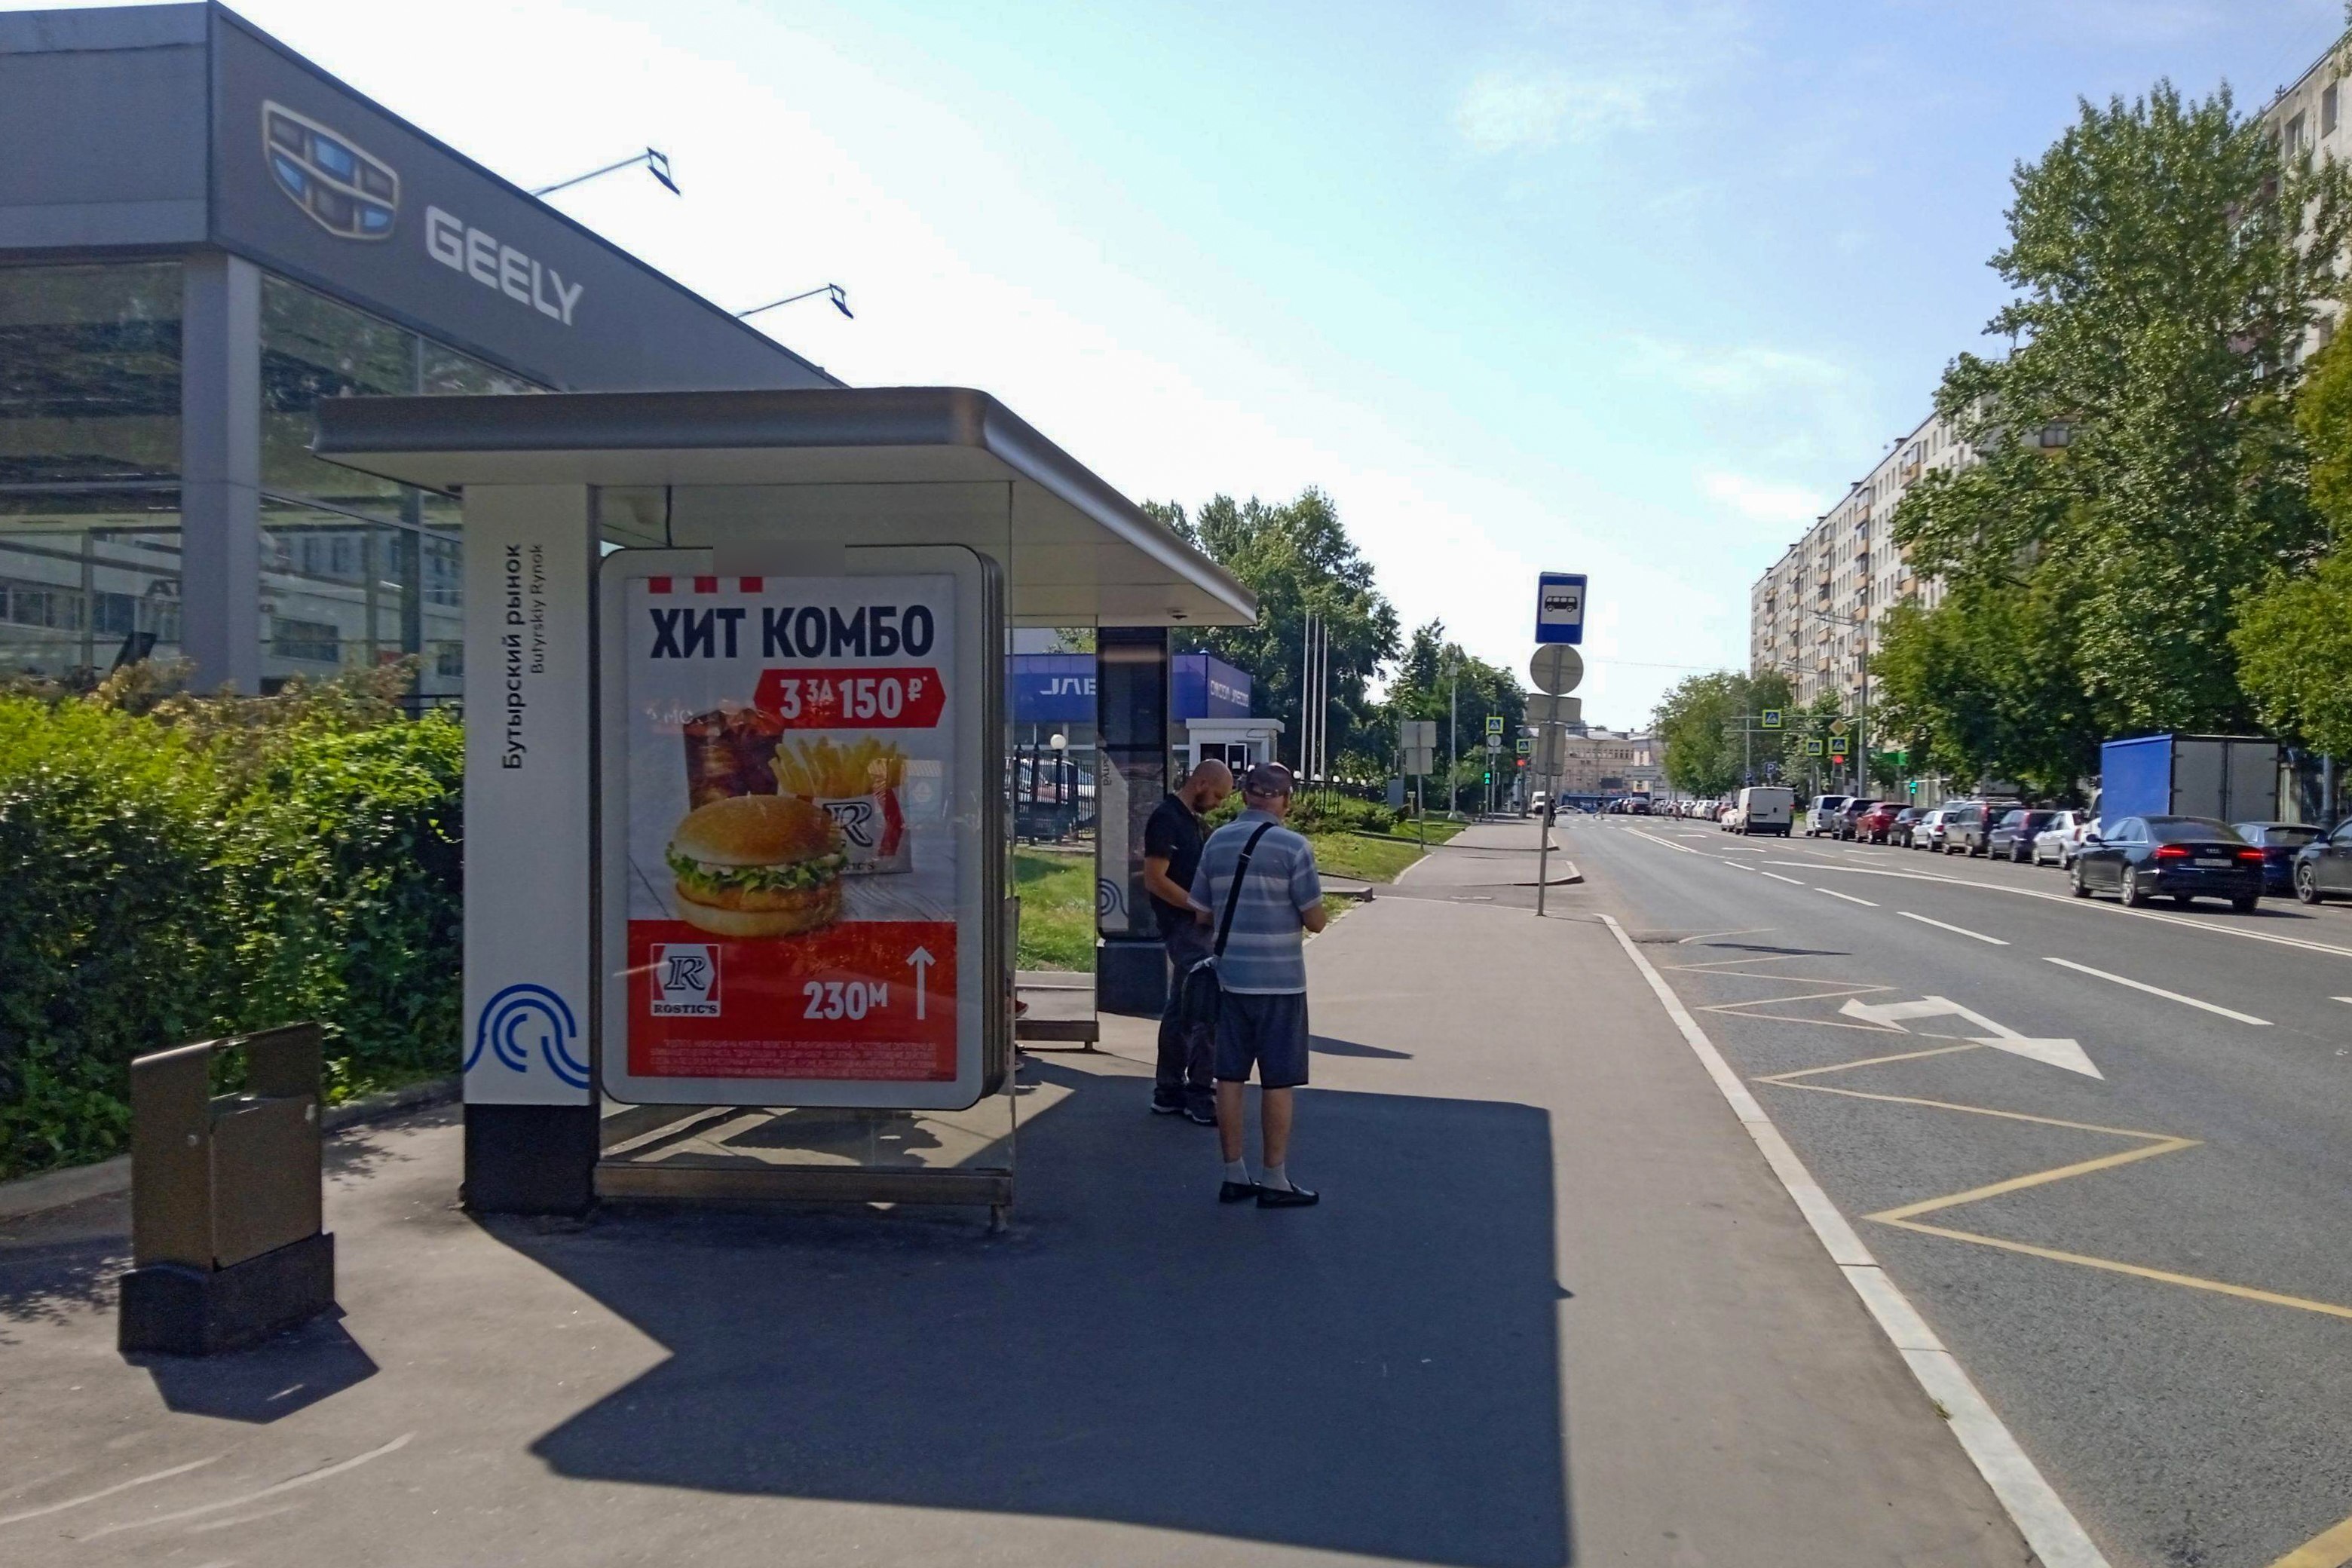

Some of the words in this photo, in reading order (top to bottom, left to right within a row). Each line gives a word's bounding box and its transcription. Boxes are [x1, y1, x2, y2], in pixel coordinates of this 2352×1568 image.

[425, 205, 584, 326] GEELY
[505, 544, 525, 626] рынок
[529, 544, 547, 595] Rynok
[529, 599, 547, 674] Butyrskiy
[649, 608, 746, 658] ХИТ
[762, 605, 934, 658] КОМБО
[501, 634, 527, 770] Бутырский
[779, 679, 802, 719] 3
[838, 678, 903, 719] 150
[654, 1004, 718, 1015] ROSTIC'S
